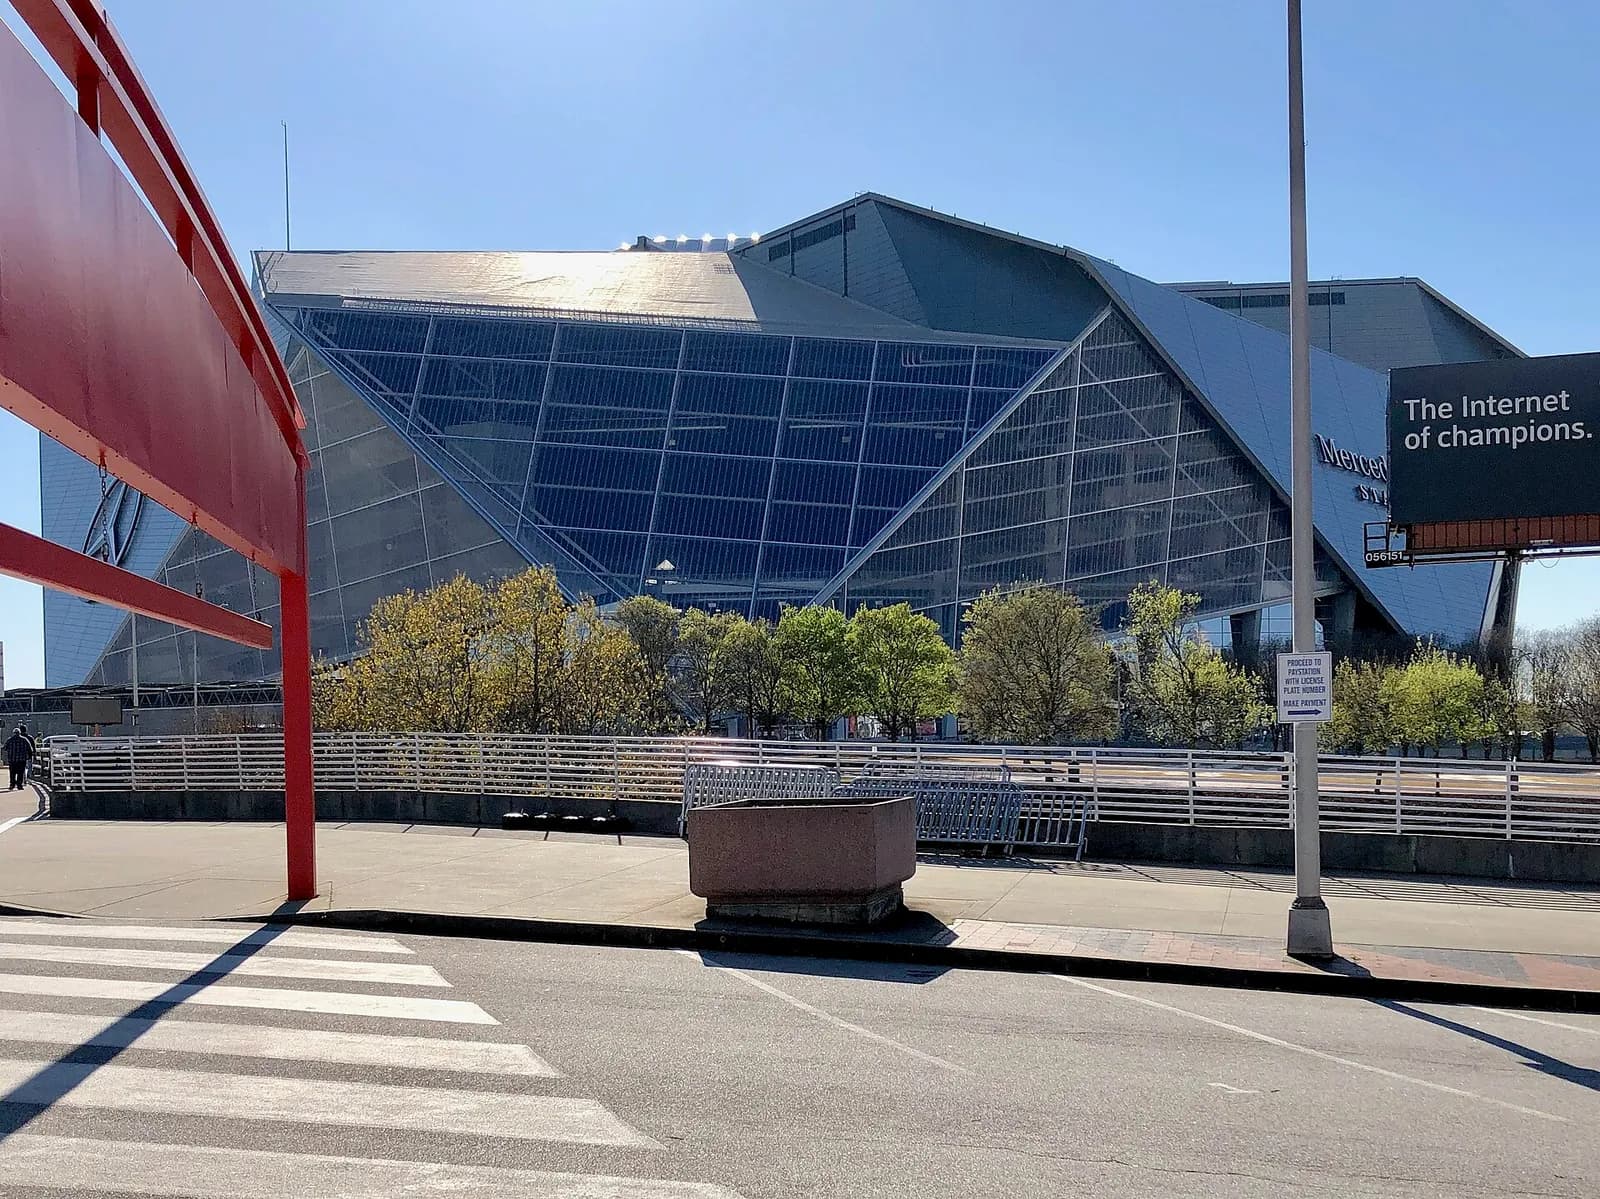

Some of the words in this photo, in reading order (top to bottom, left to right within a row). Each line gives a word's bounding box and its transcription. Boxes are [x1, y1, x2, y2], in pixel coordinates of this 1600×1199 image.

[1403, 398, 1453, 421] The
[1462, 390, 1570, 418] Internet
[1404, 426, 1431, 450] of
[1437, 419, 1593, 450] champions.
[1365, 551, 1403, 562] 056151
[1287, 659, 1313, 667] PROCEED
[1314, 658, 1322, 666] TO
[1287, 668, 1321, 676] PAYSTATION
[1284, 677, 1300, 685] WITH
[1301, 676, 1325, 685] LICENSE
[1283, 686, 1300, 695] PLATE
[1301, 685, 1326, 694] NUMBER
[1283, 699, 1299, 707] MAKE
[1300, 699, 1327, 707] PAYMENT
